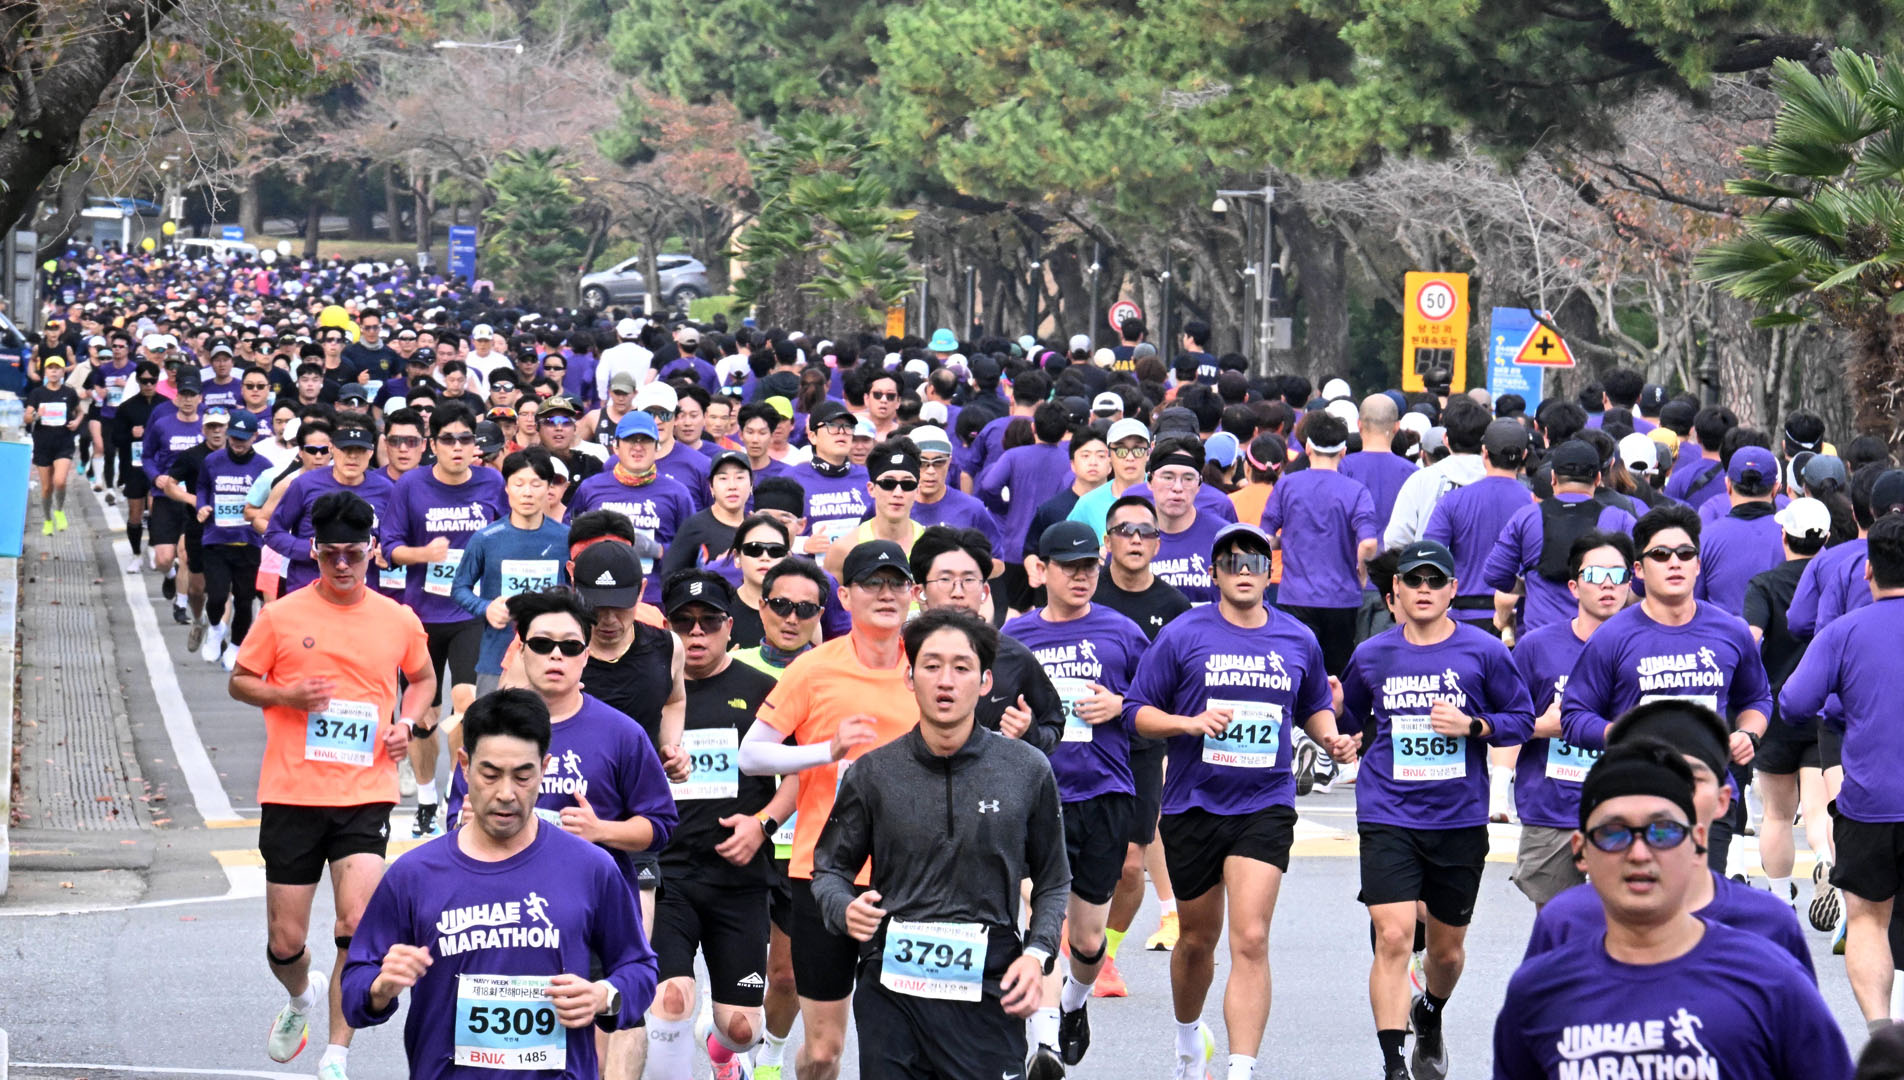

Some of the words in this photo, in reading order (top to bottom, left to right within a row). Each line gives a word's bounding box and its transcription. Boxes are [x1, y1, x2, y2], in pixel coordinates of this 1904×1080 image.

[1427, 293, 1446, 309] 50
[1118, 309, 1134, 323] 50
[215, 484, 251, 494] MARATHO
[808, 491, 852, 507] JINHAE
[425, 507, 471, 521] JINHAE
[809, 503, 867, 518] MARATHON
[425, 519, 488, 533] MARATHON
[508, 576, 552, 591] 3475
[1053, 661, 1103, 679] RATHON
[1204, 653, 1266, 672] JINHAE
[1636, 653, 1698, 676] JINHAE
[1204, 670, 1292, 692] MARATHON
[1382, 674, 1441, 696] JINHAE
[1638, 670, 1724, 692] MARATHON
[1382, 692, 1467, 710] MARATHON
[315, 718, 370, 743] 3741
[1400, 737, 1459, 756] 3565
[435, 902, 521, 936] JINHAE
[438, 927, 560, 957] MARATHON
[894, 938, 974, 972] 3794
[468, 1006, 555, 1036] 5309
[1556, 1019, 1666, 1060] JINHAE
[470, 1051, 505, 1065] BNK
[518, 1051, 547, 1064] 1485
[1558, 1054, 1719, 1080] MARATHON
